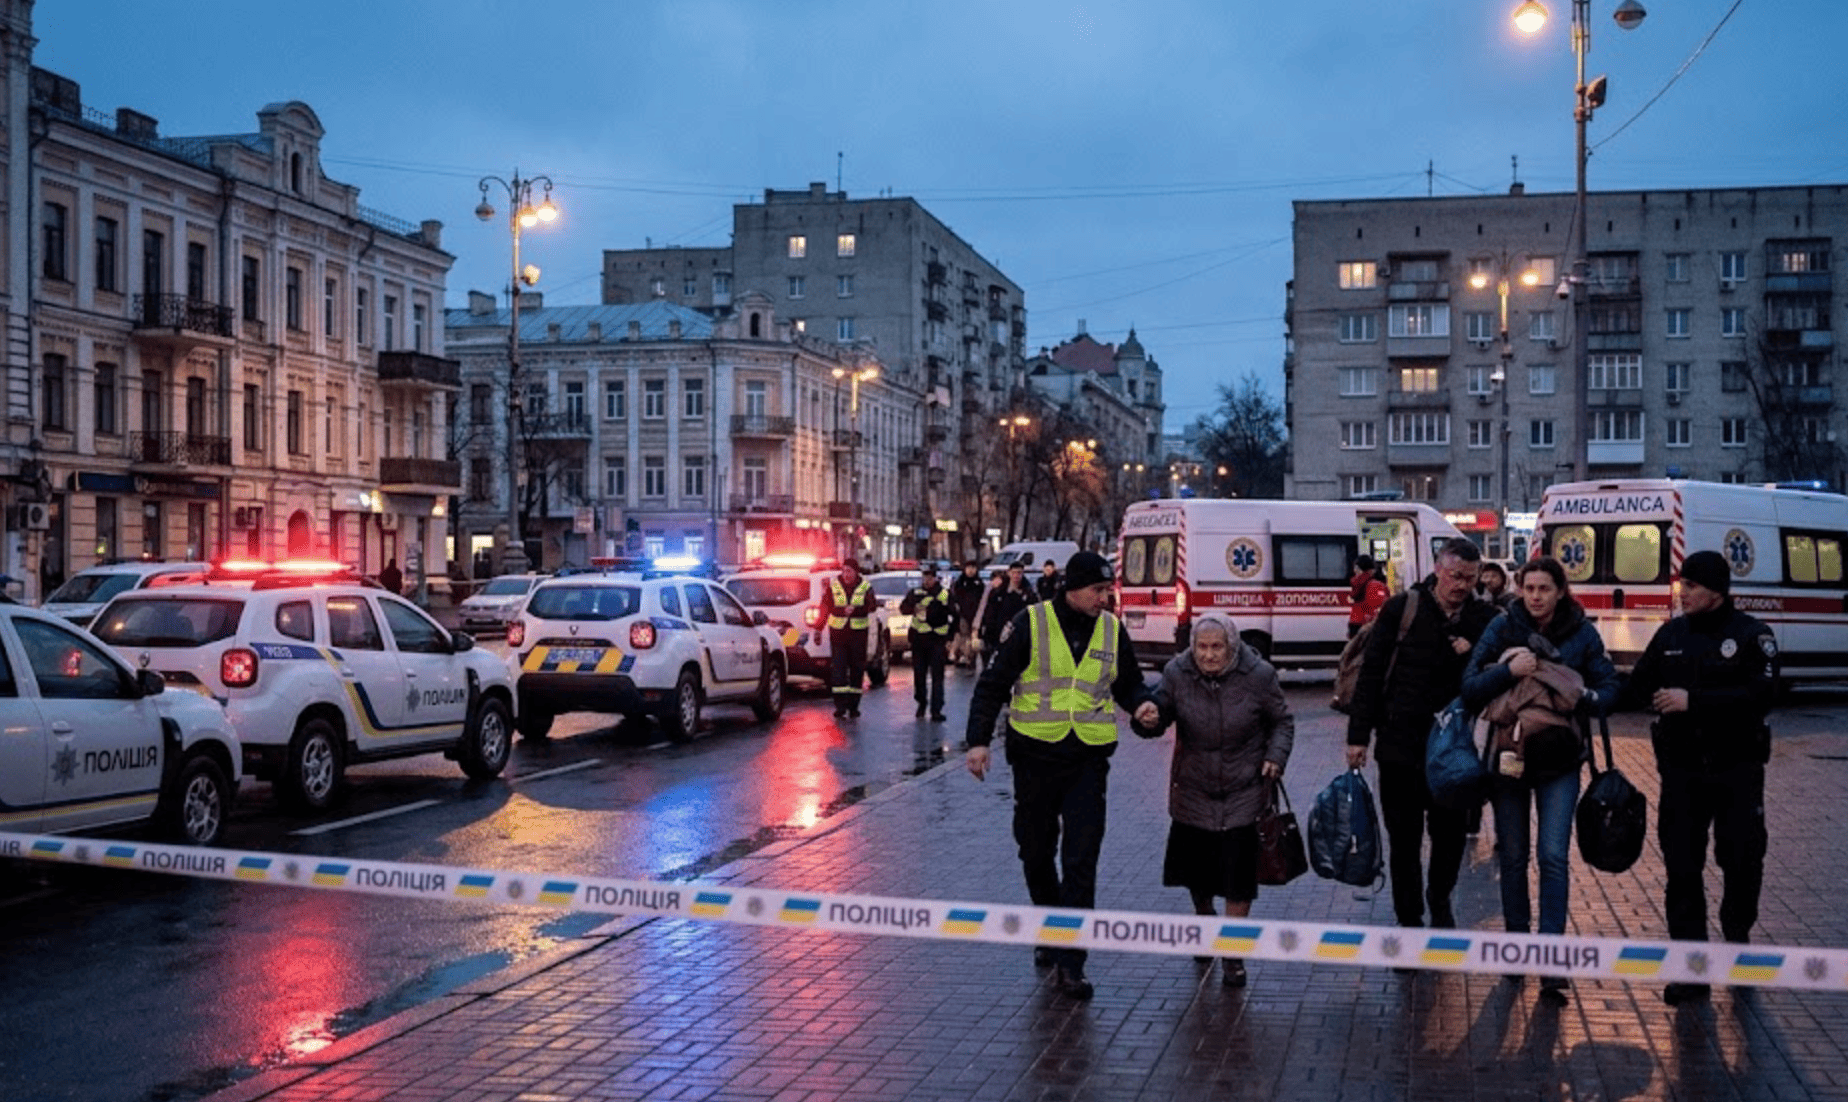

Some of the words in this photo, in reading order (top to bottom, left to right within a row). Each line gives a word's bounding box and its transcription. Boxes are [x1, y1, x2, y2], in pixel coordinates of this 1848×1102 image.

[1551, 496, 1665, 516] AMBULANCA
[84, 745, 158, 774] ПОЛІЦІЯ
[142, 850, 225, 874] ПОЛІЦІЯ
[356, 868, 446, 892] ПОЛІЦІЯ
[585, 885, 681, 910] ПОЛІЦІЯ
[829, 903, 931, 929] ПОЛІЦІЯ
[1093, 920, 1201, 946] ПОЛІЦІЯ
[1481, 941, 1599, 968] ПОЛІЦІЯ
